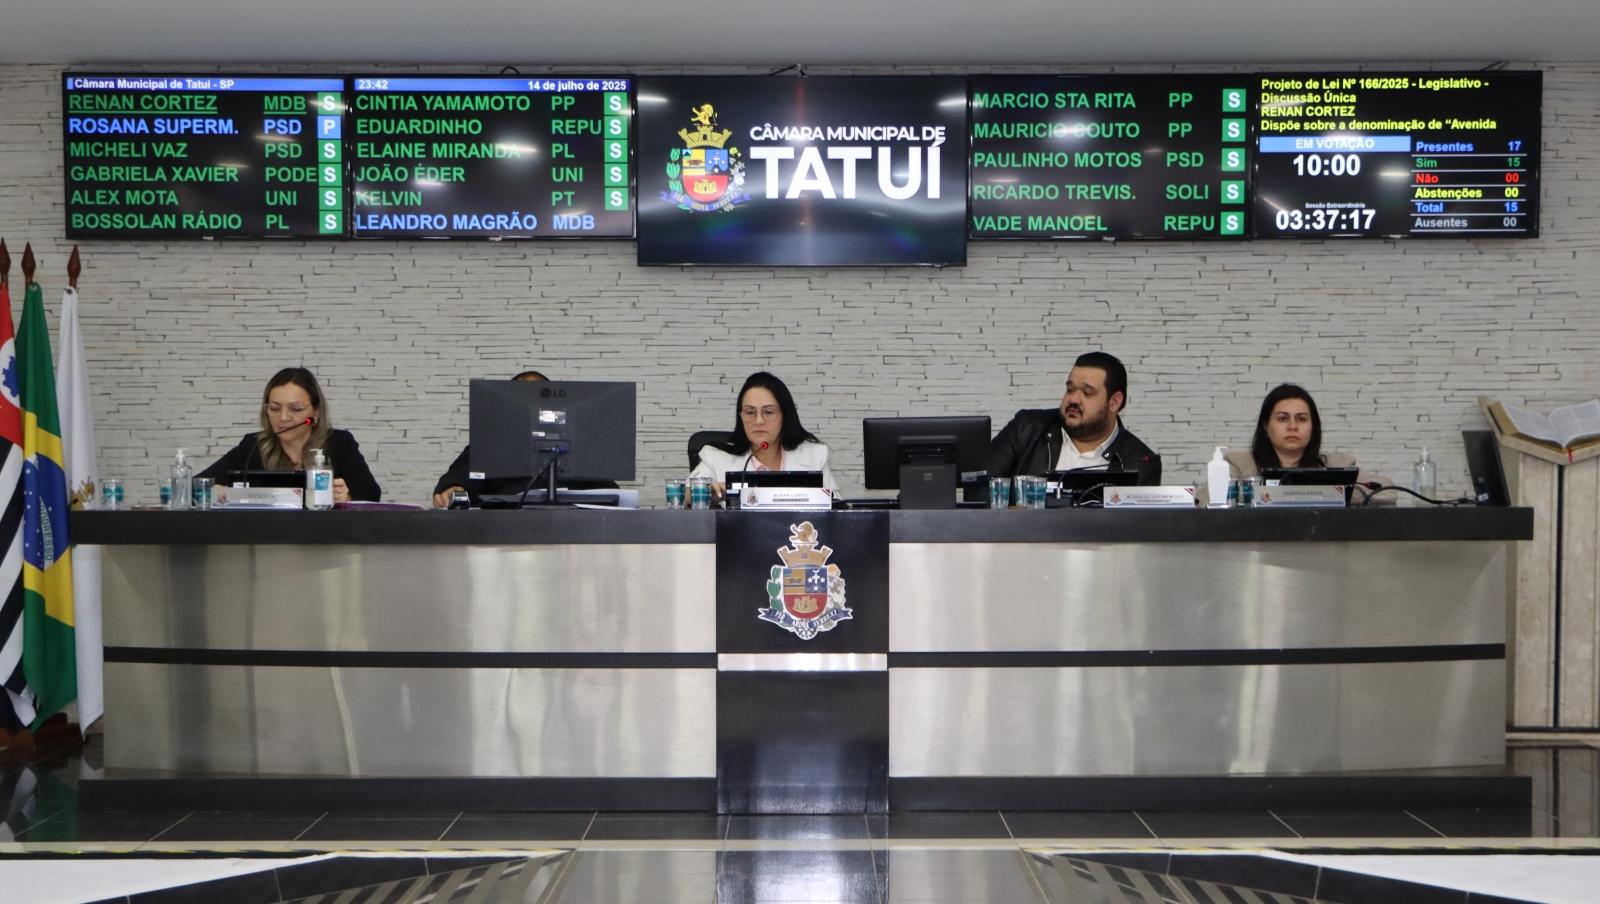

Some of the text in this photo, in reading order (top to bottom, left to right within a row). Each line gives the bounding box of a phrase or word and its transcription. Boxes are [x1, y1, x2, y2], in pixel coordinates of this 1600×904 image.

[75, 79, 115, 89] Câmara
[117, 80, 168, 91] Municipal
[170, 80, 183, 89] de
[219, 80, 234, 89] SP
[359, 80, 388, 89] 23:42
[528, 81, 626, 92] 14 de julho de 2025
[1262, 80, 1302, 91] Projeto
[1305, 80, 1318, 89] de
[1323, 79, 1339, 89] Lei
[1359, 78, 1408, 89] 166/2025
[1419, 78, 1481, 90] Legislativo
[69, 95, 335, 111] RENAN CORTEZ MDB S
[356, 95, 621, 111] CINTIA YAMAMOTO PP S
[974, 92, 1240, 108] MARCIO STA RITA PP S
[1262, 91, 1356, 103] Discussão Única
[1261, 106, 1355, 116] RENAN CORTEZ
[69, 119, 335, 134] ROSANA SUPERM. PSD P
[357, 119, 622, 135] EDUARDINHO REPU S
[750, 123, 946, 140] CÂMARA MUNICIPAL DE
[974, 122, 1240, 138] MAURICIO COUTO PP S
[1261, 120, 1300, 132] Dispõe
[1304, 120, 1336, 130] sobre
[1349, 119, 1425, 132] denominação
[1428, 119, 1442, 129] de
[70, 142, 335, 158] MICHELI VAZ PSD S
[357, 143, 622, 159] ELAINE MIRANDA PL S
[1296, 137, 1374, 151] EM VOTAÇÃO
[1416, 141, 1521, 152] Presentes 17
[974, 152, 1239, 168] PAULINHO MOTOS PSD S
[1293, 154, 1360, 176] 10:00
[1416, 158, 1520, 168] Sim 15
[71, 167, 335, 182] GABRIELA XAVIER PODE S
[357, 164, 622, 183] JOÃO ÉDER UNI S
[750, 139, 946, 200] TATUÍ
[1416, 173, 1519, 183] Não 00
[71, 190, 336, 206] ALEX MOTA UNI S
[356, 191, 622, 206] KELVIN PT S
[974, 184, 1239, 200] RICARDO TREVIS. SOLI S
[1415, 188, 1518, 199] Abstenções 00
[1416, 202, 1518, 213] Total 15
[72, 210, 337, 230] BOSSOLAN RÁDIO PL S
[357, 211, 595, 230] LEANDRO MAGRÃO MDB
[973, 215, 1238, 231] VADE MANOEL REPU S
[1276, 209, 1375, 230] 03:37:17
[1415, 217, 1517, 227] Ausentes 00
[553, 389, 566, 397] LG
